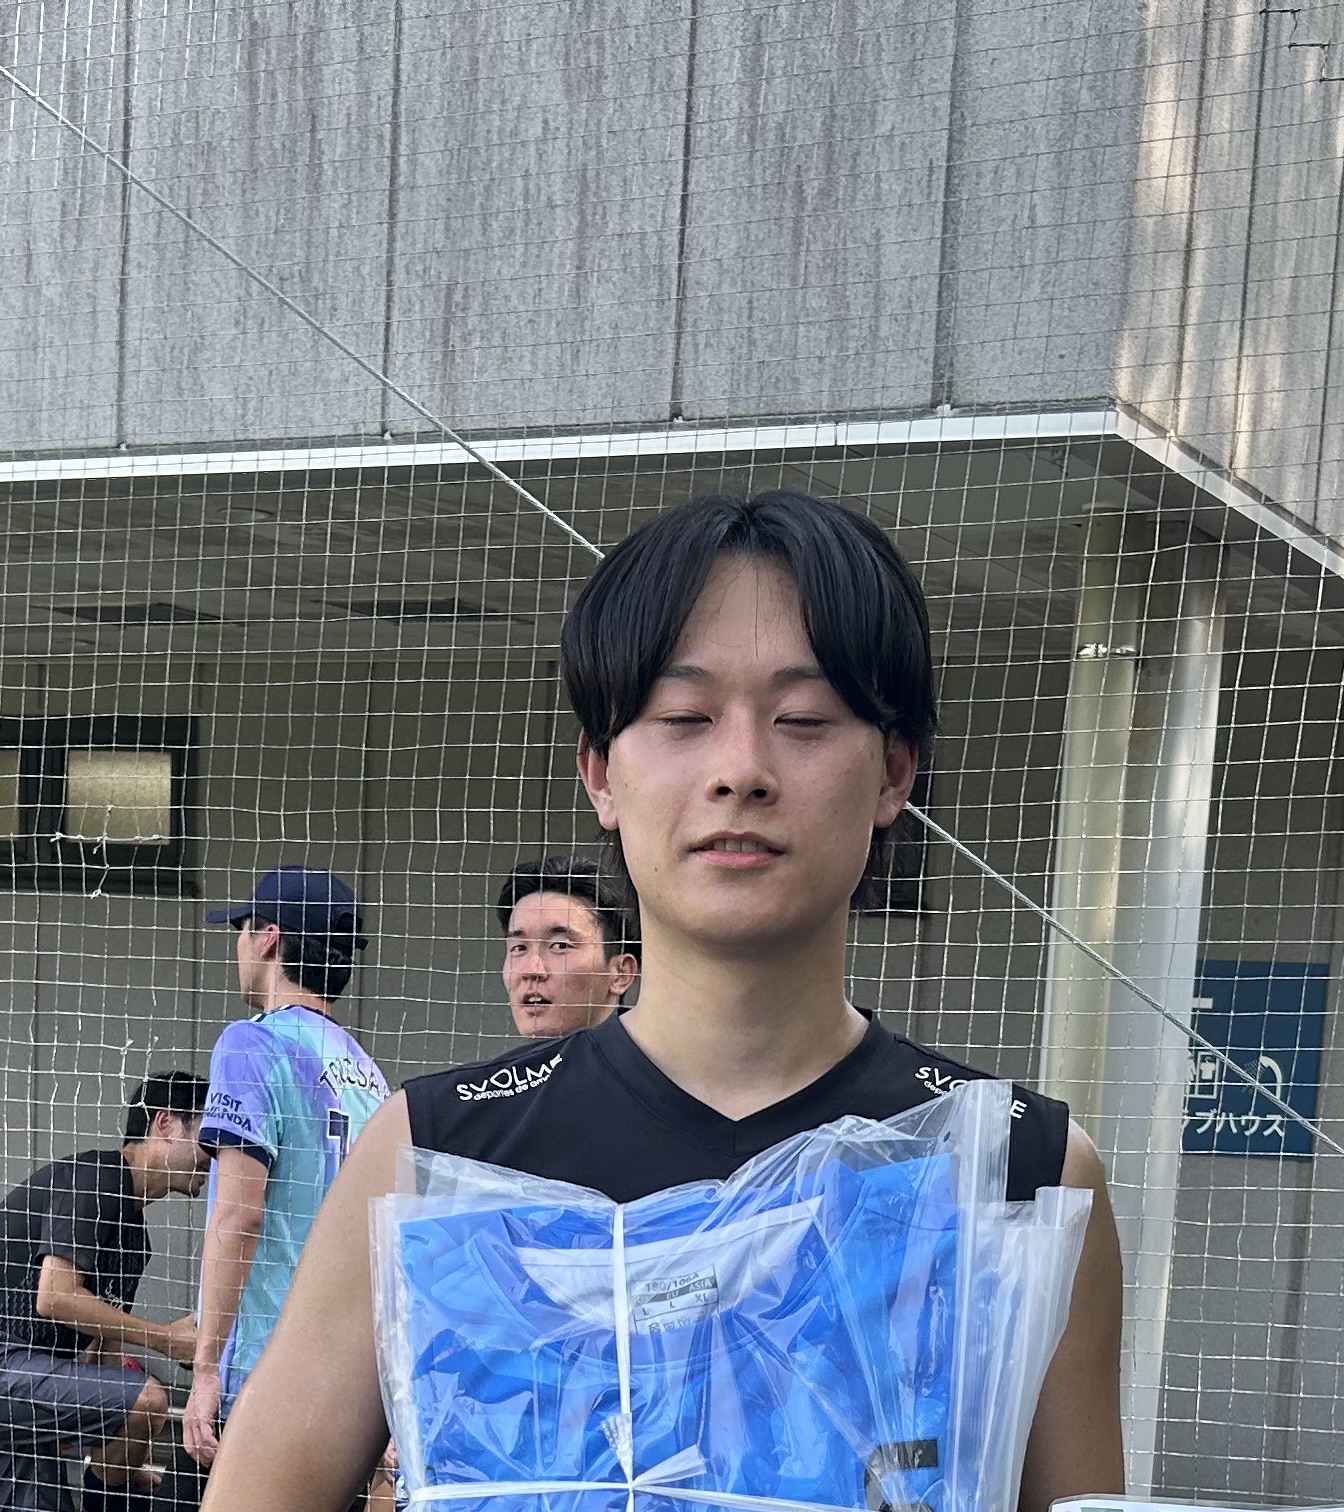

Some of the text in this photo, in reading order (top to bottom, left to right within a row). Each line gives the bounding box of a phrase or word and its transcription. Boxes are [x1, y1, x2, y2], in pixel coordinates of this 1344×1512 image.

[456, 1053, 563, 1101] SVOLME
[210, 1091, 243, 1112] VISIT
[1183, 1108, 1285, 1137] ブハウス
